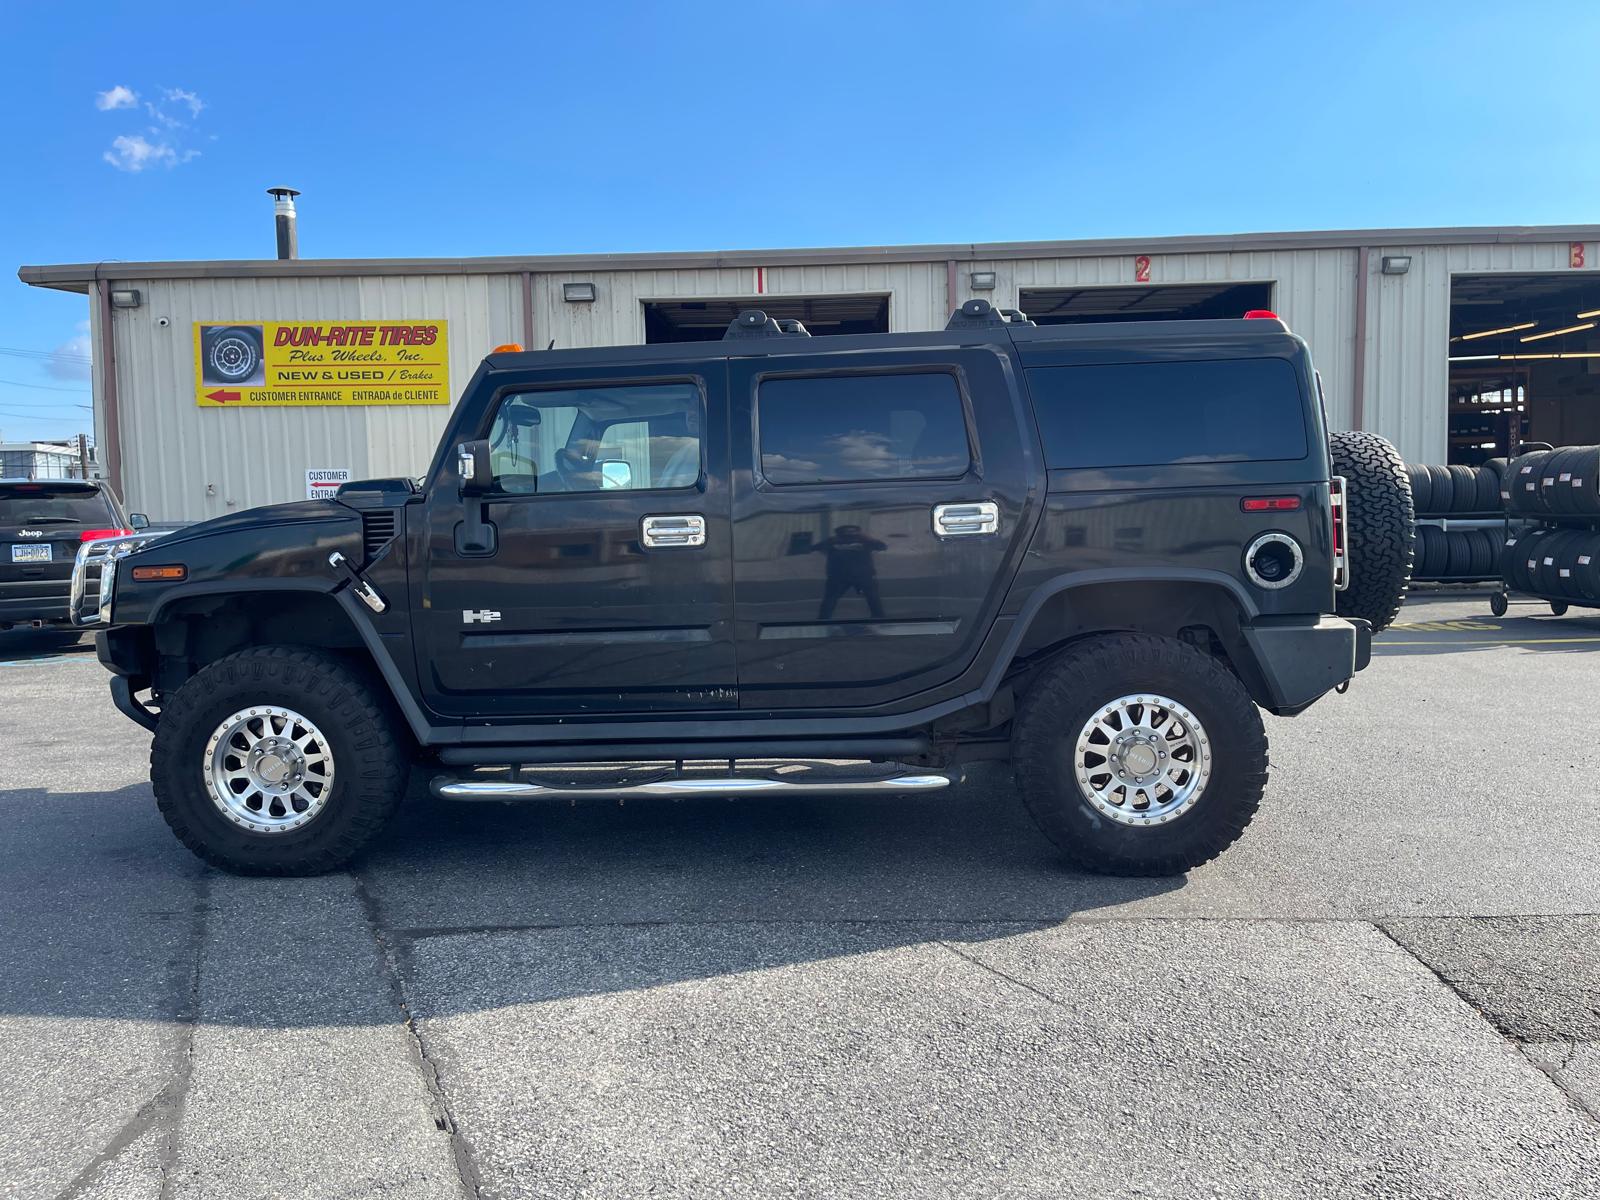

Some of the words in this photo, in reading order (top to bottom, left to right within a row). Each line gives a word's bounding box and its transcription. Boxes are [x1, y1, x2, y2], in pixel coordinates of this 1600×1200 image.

[1571, 241, 1584, 268] 3
[1136, 256, 1150, 282] 2
[273, 326, 377, 347] DUN-RITE
[379, 325, 439, 346] TIRES
[289, 349, 324, 363] Plus
[396, 349, 424, 361] Inc.
[278, 371, 318, 380] NEW
[322, 371, 334, 380] &
[337, 370, 384, 380] USED
[399, 369, 433, 380] Brakes
[249, 391, 297, 401] CUSTOMER
[298, 390, 342, 401] ENTRANCE
[352, 390, 391, 401] ENTRADA
[392, 390, 402, 400] de
[404, 390, 439, 400] CLIENTE
[308, 471, 348, 481] CUSTOMER
[310, 489, 337, 499] ENTRA
[18, 529, 43, 538] Jeep
[462, 609, 502, 624] H2
